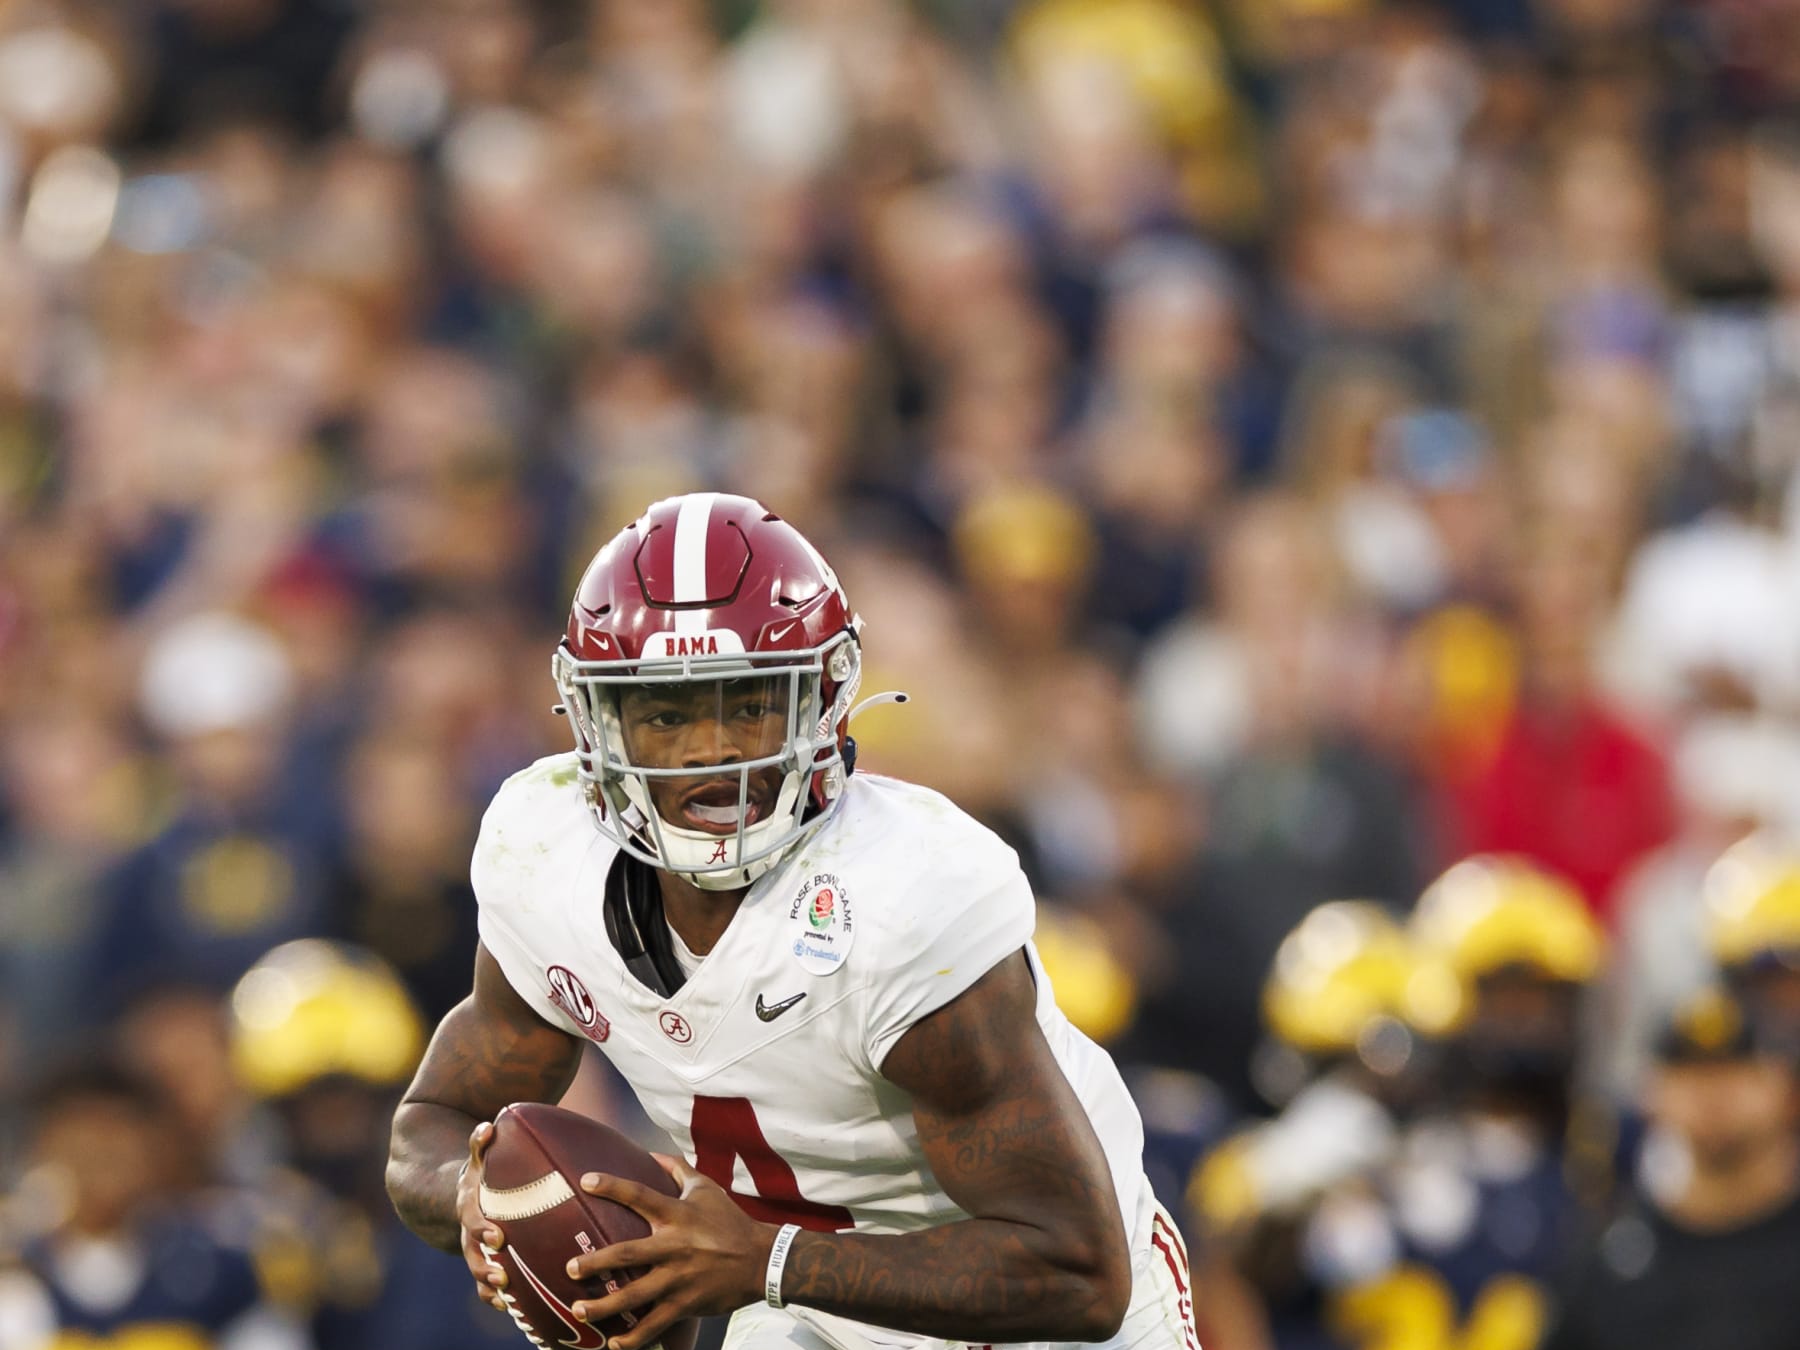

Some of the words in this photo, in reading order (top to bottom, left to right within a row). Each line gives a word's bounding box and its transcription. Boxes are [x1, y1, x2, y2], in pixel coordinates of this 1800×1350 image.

[665, 636, 718, 656] BAMA
[705, 839, 727, 865] A
[790, 881, 812, 920] ROSE
[814, 874, 839, 891] BOWL
[839, 888, 852, 933] GAME
[666, 1017, 686, 1036] A
[691, 1096, 856, 1233] 4
[771, 1229, 792, 1267] HUMBLE
